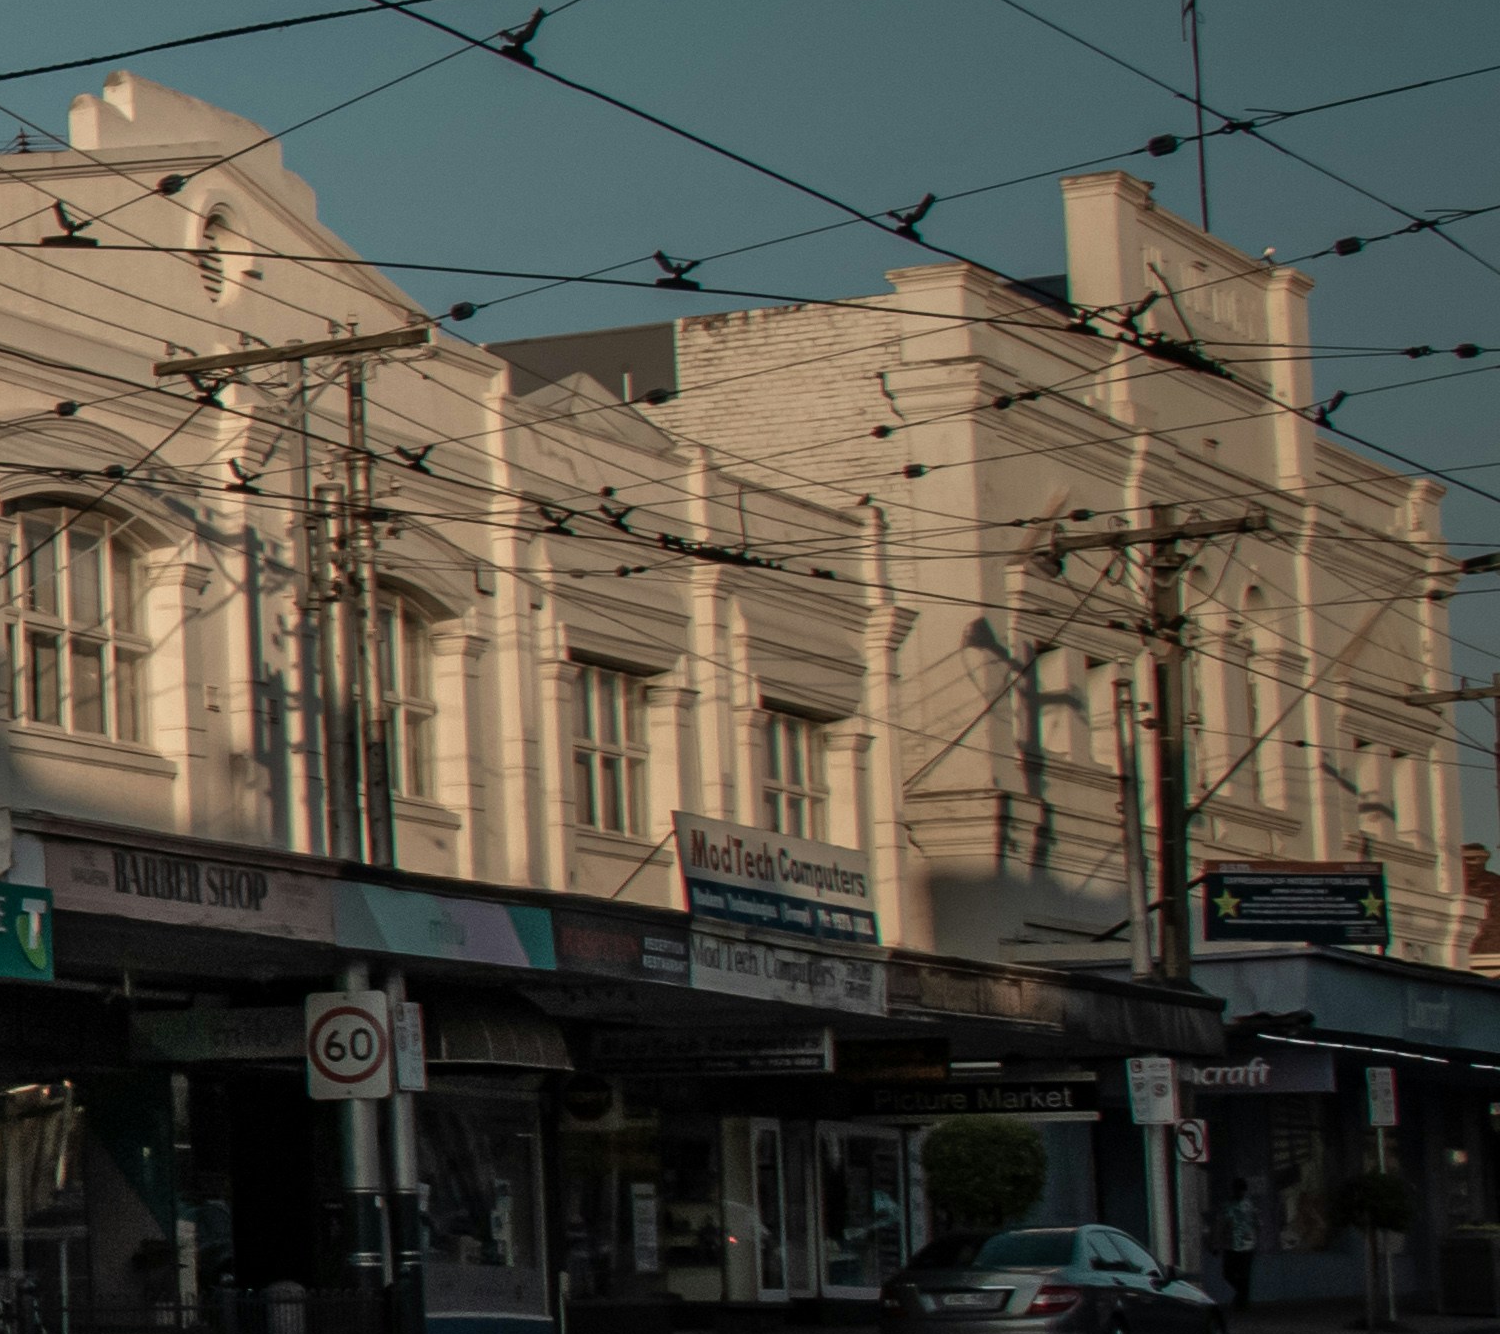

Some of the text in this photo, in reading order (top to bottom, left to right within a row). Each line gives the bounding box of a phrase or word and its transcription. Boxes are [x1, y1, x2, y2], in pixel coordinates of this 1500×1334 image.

[112, 849, 203, 906] BARBER
[205, 865, 269, 912] SHOP
[690, 828, 868, 899] ModTech Computers
[322, 1028, 374, 1062] 60
[875, 1085, 1077, 1113] Picture Market
